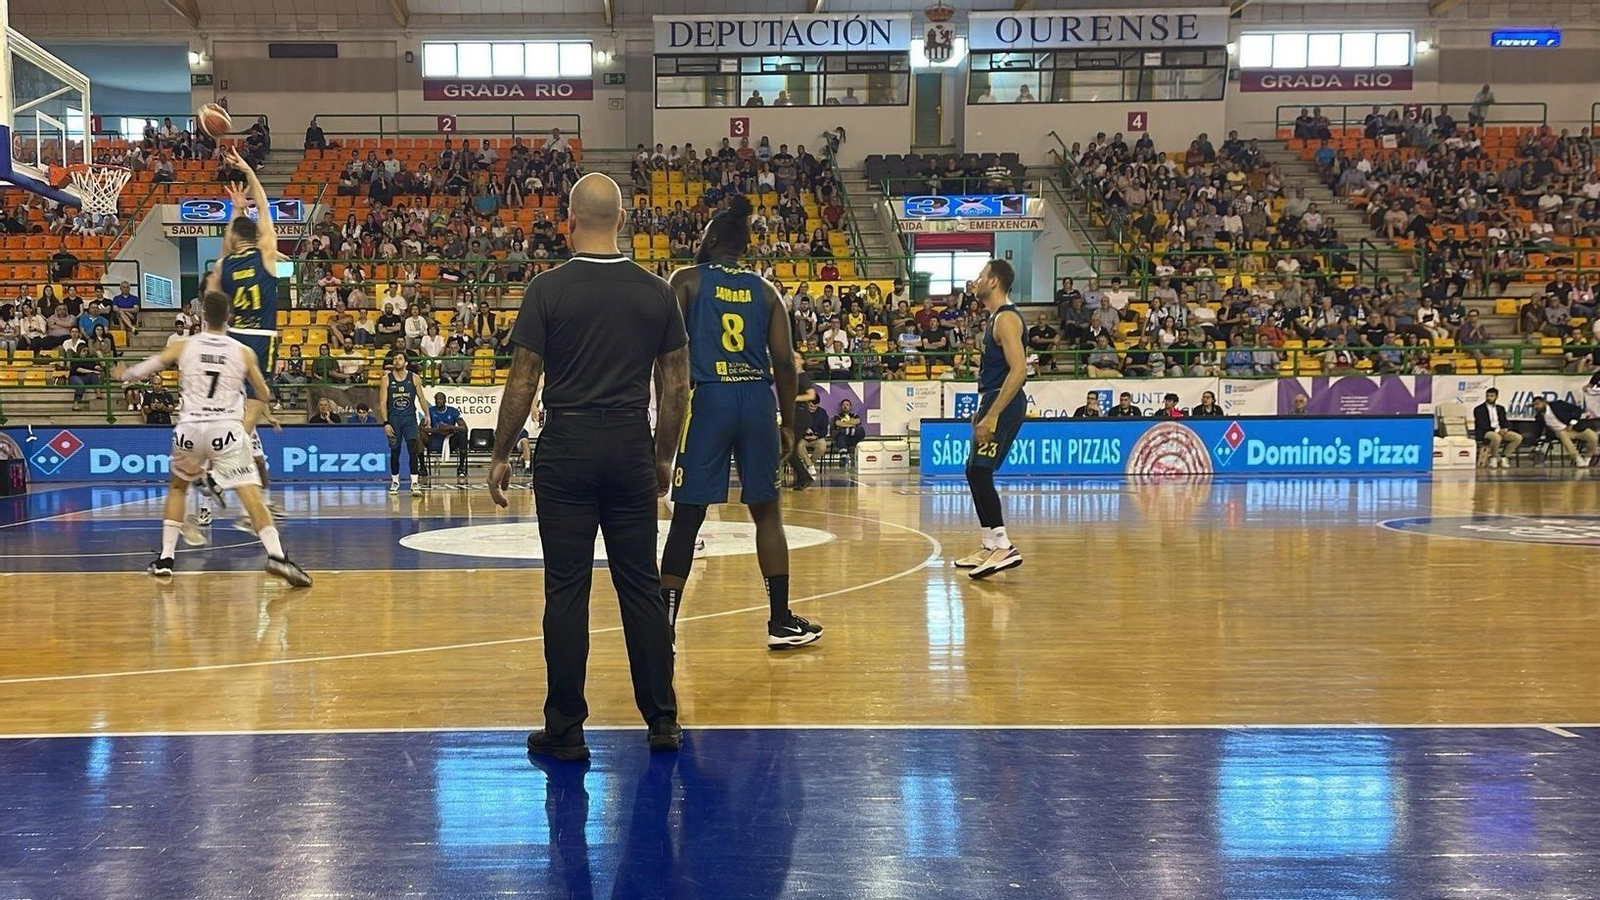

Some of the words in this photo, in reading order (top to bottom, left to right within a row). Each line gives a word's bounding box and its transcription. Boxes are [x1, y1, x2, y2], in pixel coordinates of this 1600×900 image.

[669, 15, 892, 48] DEPUTACIÓN
[995, 14, 1199, 43] OURENSE
[443, 83, 525, 97] GRADA
[535, 83, 574, 97] RIO
[1260, 74, 1342, 88] GRADA
[1353, 73, 1393, 87] RIO
[442, 117, 452, 131] 2
[734, 120, 745, 134] 3
[1132, 114, 1143, 129] 4
[969, 219, 1039, 231] EMERXENCIA
[233, 283, 262, 310] 41
[721, 312, 745, 353] 8
[204, 370, 221, 399] 7
[447, 396, 497, 404] DEPORTE
[457, 405, 492, 415] ALEGO
[283, 444, 386, 473] Pizza
[931, 433, 972, 466] SÁBA
[1008, 439, 1036, 466] 3X1
[1041, 438, 1062, 465] EN
[1068, 438, 1121, 465] PIZZAS
[977, 442, 999, 459] 23
[1246, 436, 1351, 466] Domino's
[1358, 436, 1419, 465] Pizza
[674, 466, 684, 487] 8
